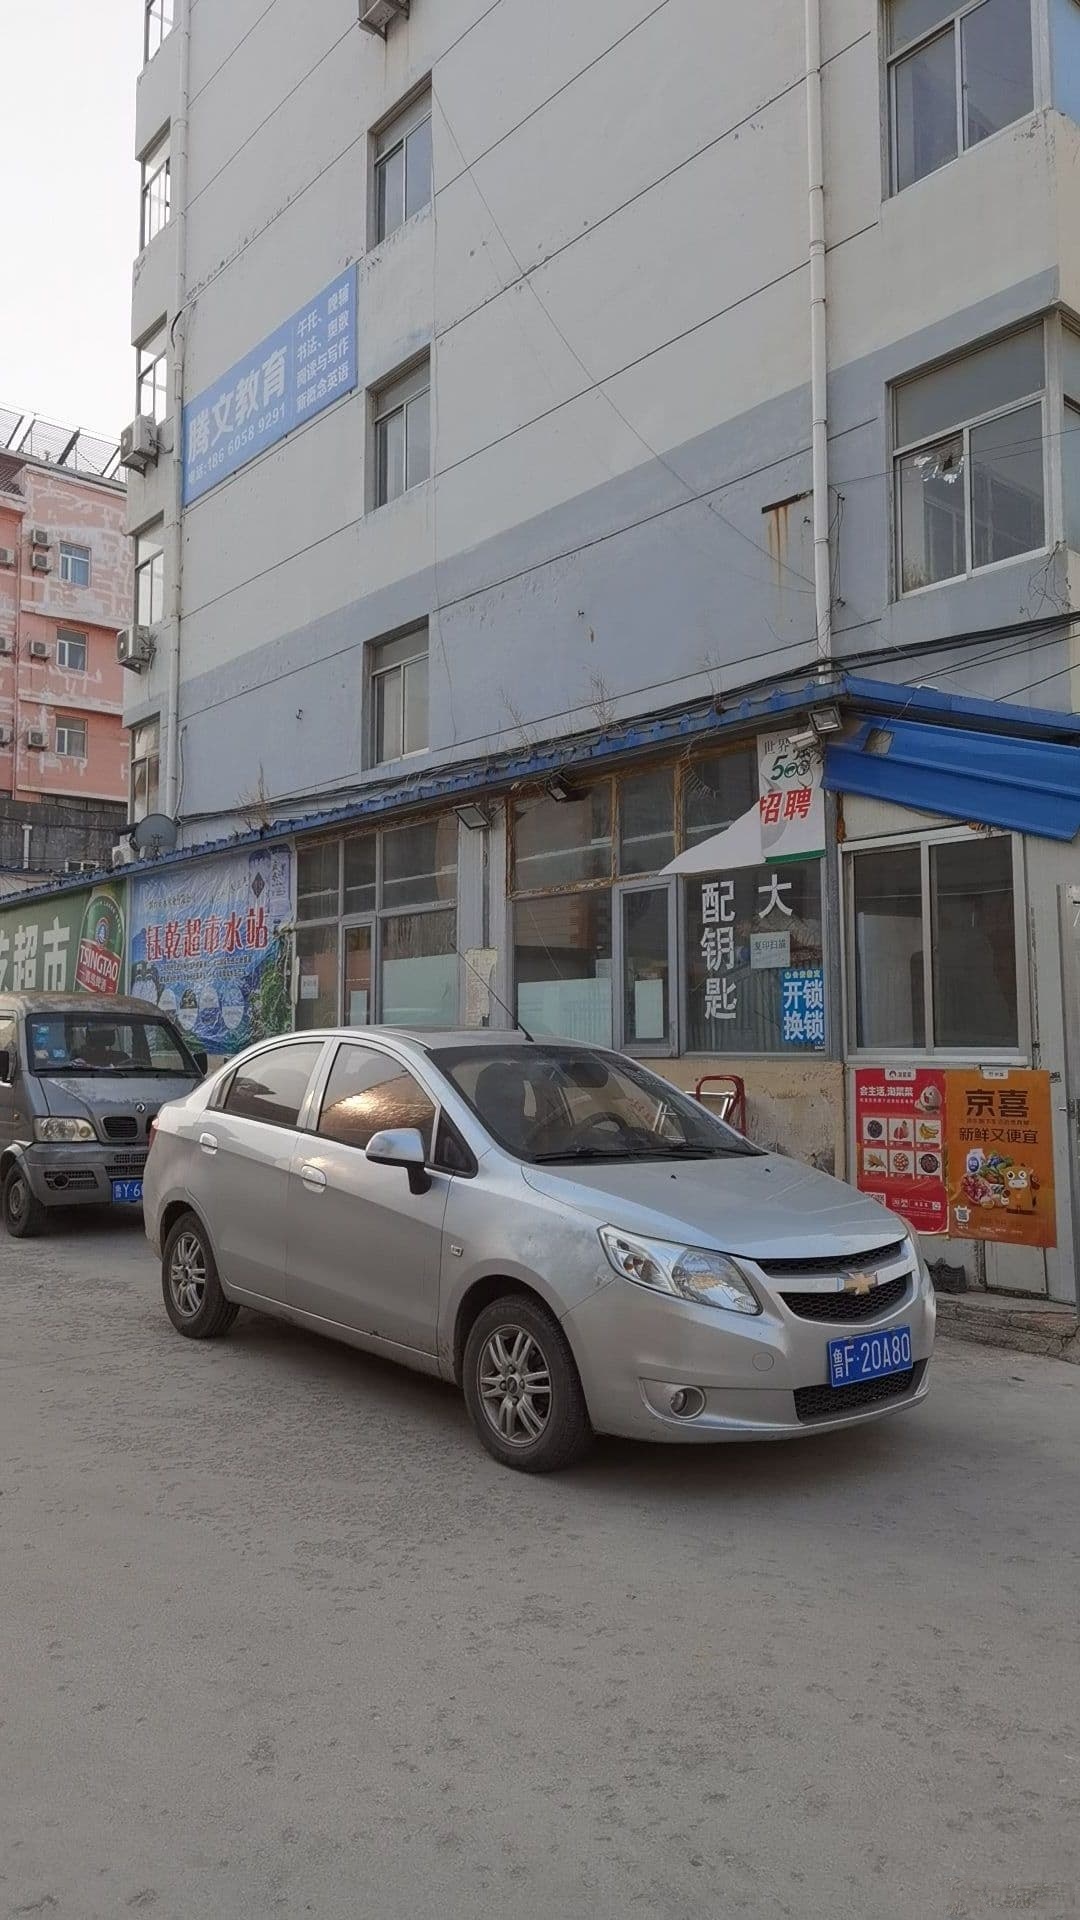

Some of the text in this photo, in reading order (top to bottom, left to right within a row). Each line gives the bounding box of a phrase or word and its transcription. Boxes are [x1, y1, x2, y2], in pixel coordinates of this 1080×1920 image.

[188, 345, 287, 465] 腾文教育
[297, 361, 350, 413] 新概念英语
[227, 424, 255, 456] 6058
[258, 401, 286, 434] 9291
[760, 787, 812, 824] 招聘
[758, 873, 793, 919] 大
[80, 944, 118, 981] TSINGTAO
[700, 880, 737, 1020] 配钥匙
[754, 939, 786, 951] 复印扫描
[783, 979, 823, 1009] 开锁
[783, 1010, 824, 1040] 换锁
[965, 1088, 1029, 1118] 京喜
[959, 1127, 1039, 1144] 新鲜又便宜
